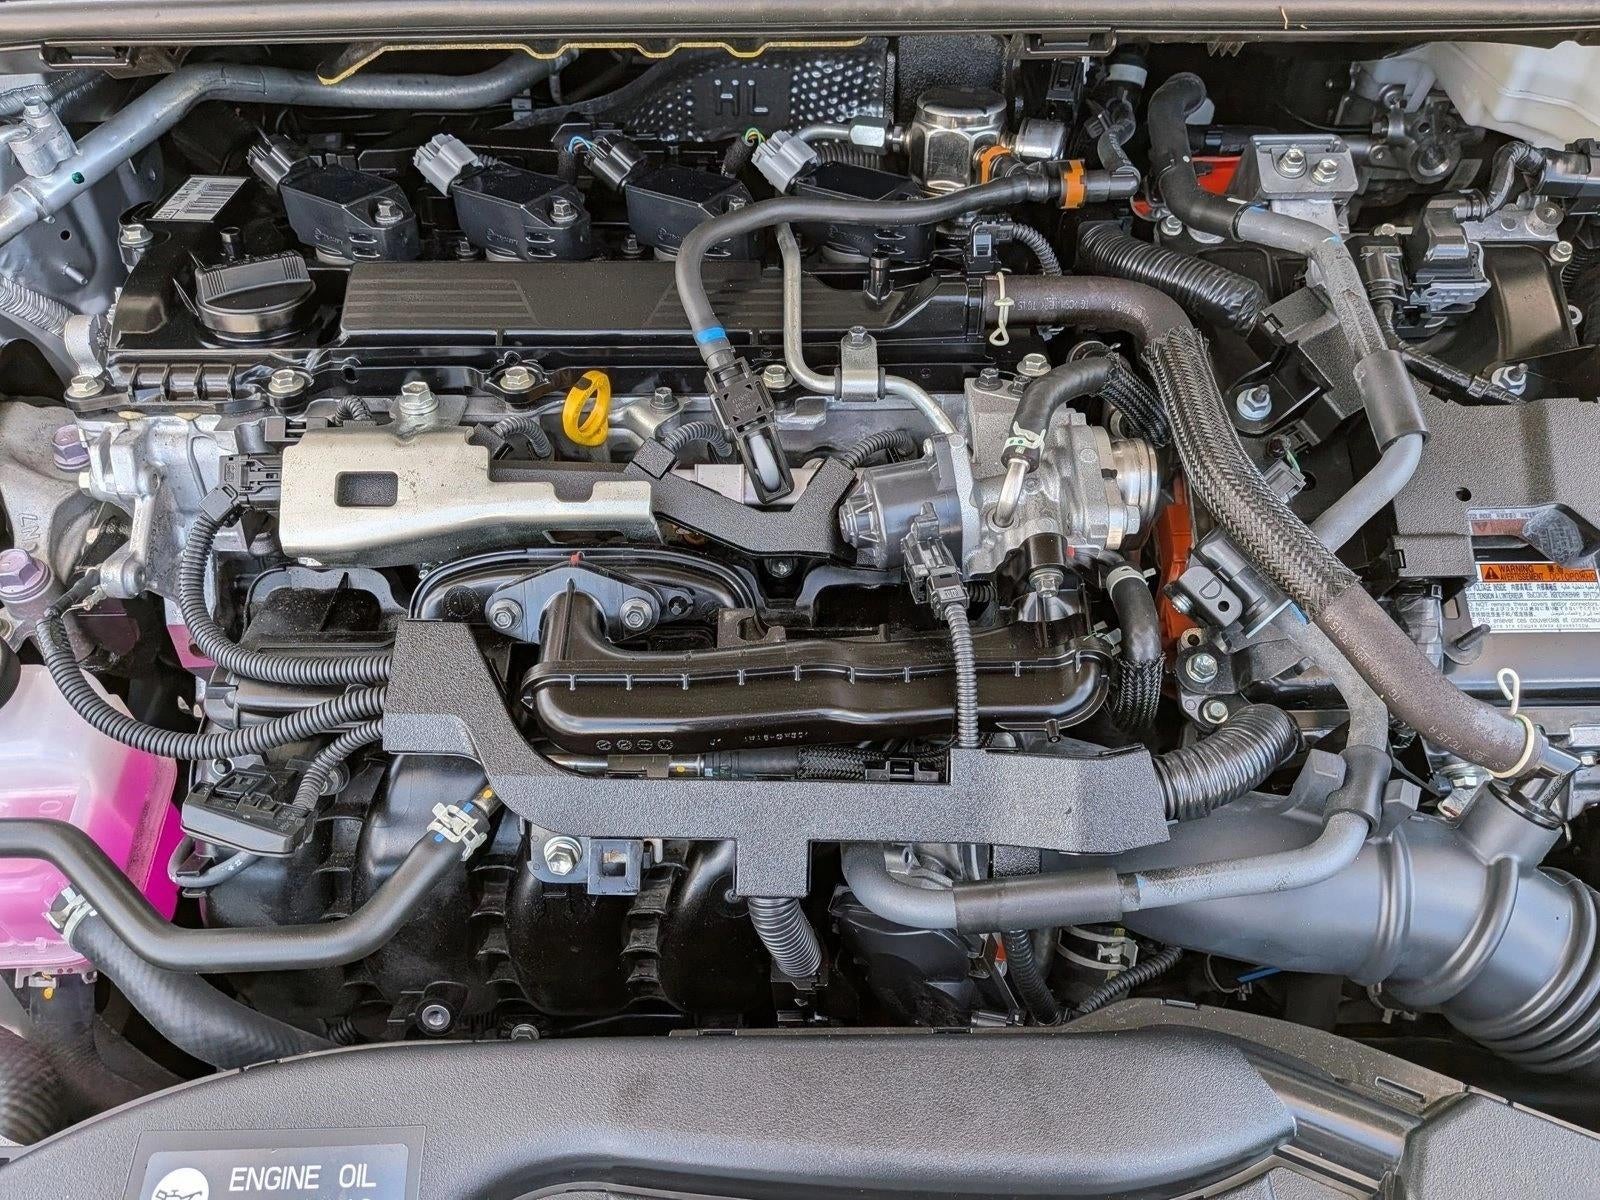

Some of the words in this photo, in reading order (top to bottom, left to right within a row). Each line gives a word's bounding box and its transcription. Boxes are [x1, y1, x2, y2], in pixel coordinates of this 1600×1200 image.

[1500, 564, 1534, 573] WARNING
[1500, 572, 1544, 581] AVERTISSEMENT
[1199, 577, 1222, 599] D
[229, 1164, 322, 1192] ENGINE
[339, 1163, 377, 1189] OIL
